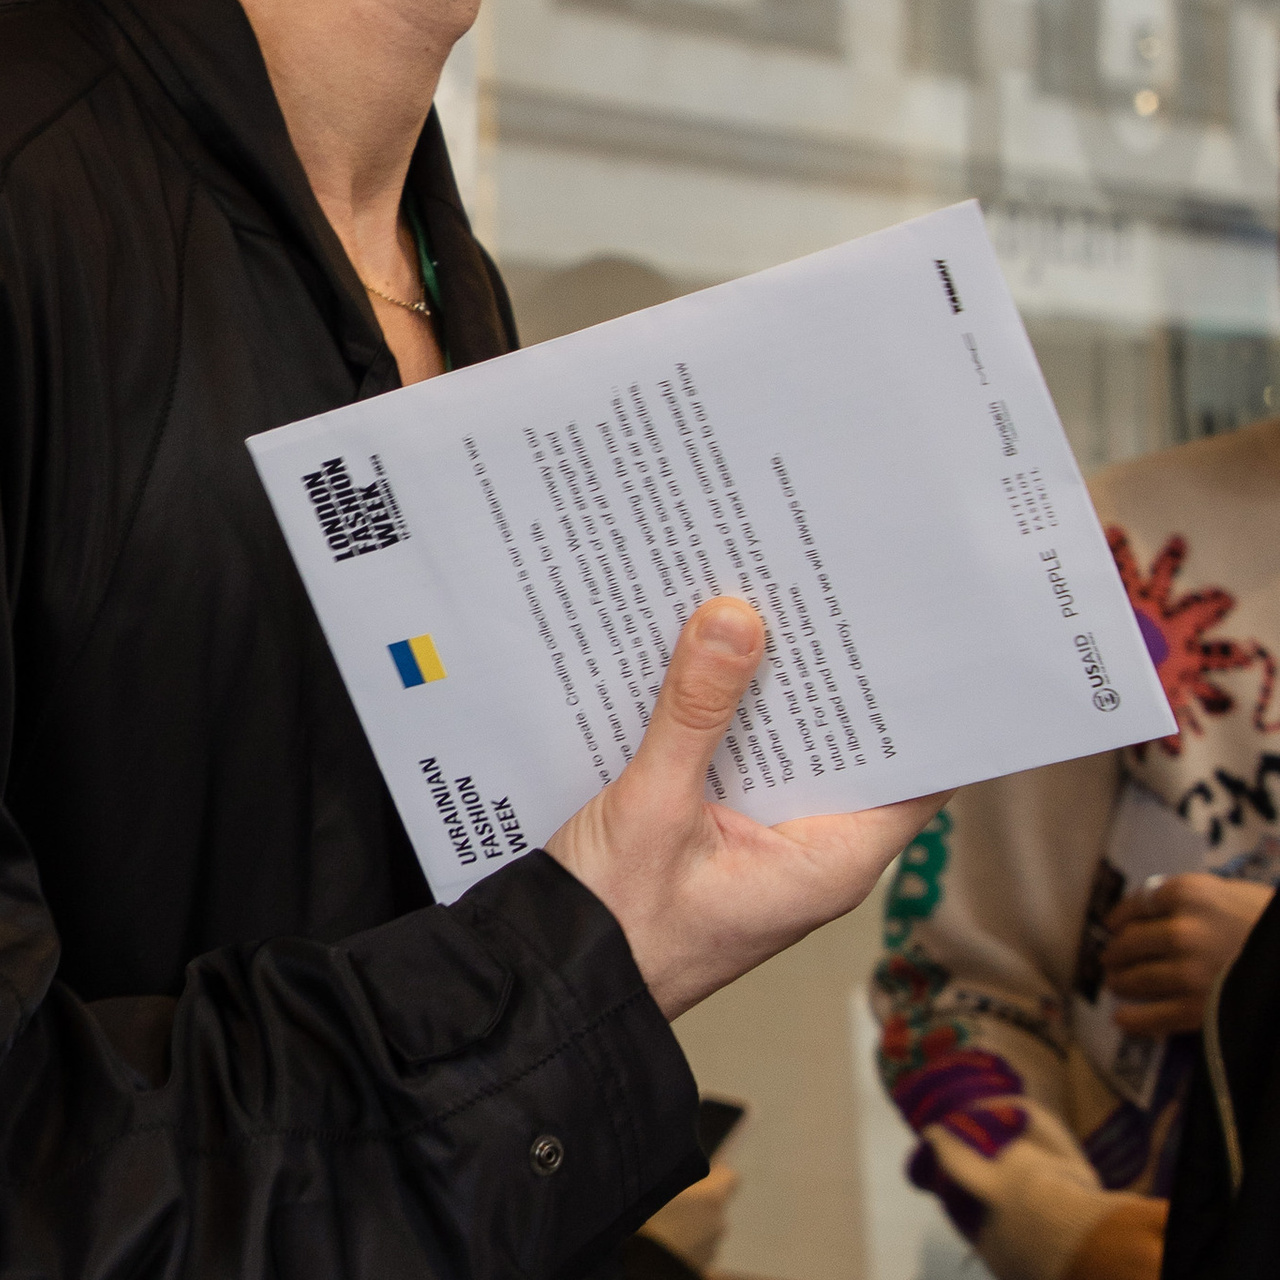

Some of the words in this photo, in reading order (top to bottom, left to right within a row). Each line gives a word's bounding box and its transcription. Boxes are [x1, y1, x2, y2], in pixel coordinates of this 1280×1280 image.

[674, 361, 697, 397] show
[627, 379, 664, 454] collections.
[655, 378, 694, 437] peaceful
[689, 400, 708, 422] our
[522, 426, 540, 449] our
[542, 430, 566, 456] and
[594, 420, 620, 454] most
[699, 423, 715, 439] to
[461, 432, 480, 461] war.
[532, 449, 546, 463] is
[565, 419, 602, 493] Ukrainians.
[626, 440, 644, 457] air
[472, 461, 487, 477] to
[611, 455, 629, 478] the
[631, 459, 650, 474] of
[656, 455, 674, 478] the
[682, 437, 714, 495] common
[705, 439, 735, 488] season
[769, 451, 796, 498] create.
[537, 464, 567, 512] runway
[556, 457, 588, 511] strength
[621, 478, 636, 493] in
[665, 478, 682, 497] on
[319, 455, 381, 557] FASHION
[479, 477, 515, 544] resistance
[591, 493, 610, 510] all
[641, 474, 670, 523] sounds
[706, 497, 724, 520] our
[724, 489, 748, 520] next
[299, 469, 357, 564] LONDON
[355, 479, 401, 550] WEEK
[580, 513, 598, 536] our
[598, 511, 616, 526] of
[627, 493, 657, 546] working
[672, 498, 695, 532] work
[713, 521, 731, 535] of
[787, 499, 815, 546] always
[529, 518, 546, 543] life.
[557, 512, 582, 553] Week
[586, 537, 604, 552] of
[662, 524, 680, 548] the
[687, 532, 702, 548] to
[738, 521, 761, 547] you
[506, 545, 524, 568] our
[538, 544, 554, 563] for
[608, 527, 638, 581] courage
[722, 537, 745, 569] sake
[746, 548, 765, 562] of
[803, 547, 824, 571] will
[516, 568, 530, 582] is
[574, 552, 604, 606] Fashion
[594, 552, 629, 612] fulfilment
[648, 546, 678, 598] Despite
[671, 549, 696, 587] under
[691, 548, 723, 598] ontinue
[737, 570, 755, 593] the
[753, 563, 772, 580] all
[545, 564, 578, 621] creativity
[630, 582, 648, 605] the
[816, 572, 833, 593] we
[1038, 547, 1079, 619] PURPLE
[521, 582, 558, 650] collections
[636, 605, 654, 620] of
[667, 598, 695, 631] hing.
[763, 581, 791, 629] inviting
[787, 582, 816, 638] Ukraine.
[822, 594, 842, 618] but
[596, 606, 625, 656] London
[620, 613, 639, 635] the
[779, 630, 797, 645] of
[567, 621, 593, 656] need
[630, 635, 644, 649] is
[644, 621, 673, 667] flection
[808, 638, 828, 666] free
[834, 618, 863, 671] destroy,
[584, 657, 601, 678] we
[617, 656, 634, 679] the
[635, 649, 655, 680] This
[766, 655, 784, 669] of
[789, 646, 811, 679] sake
[1072, 633, 1105, 689] USAID
[549, 650, 580, 707] Creating
[626, 679, 641, 698] on
[645, 681, 663, 698] ill.
[744, 676, 763, 697] ou
[773, 670, 792, 687] all
[802, 680, 820, 703] the
[816, 667, 838, 693] and
[854, 673, 879, 710] never
[594, 678, 614, 711] ever,
[781, 688, 803, 716] that
[631, 700, 653, 727] how
[733, 706, 754, 732] and
[753, 697, 773, 726] with
[811, 705, 830, 728] For
[826, 694, 862, 752] liberated
[867, 711, 888, 734] will
[574, 707, 599, 752] create.
[606, 711, 627, 743] than
[793, 717, 817, 752] know
[591, 753, 605, 768] to
[620, 743, 636, 762] ore
[724, 734, 749, 775] create
[746, 733, 777, 789] unstable
[765, 728, 796, 785] Together
[823, 729, 847, 772] future.
[853, 752, 867, 767] in
[879, 735, 898, 760] We
[595, 768, 613, 785] ve
[808, 753, 826, 777] We
[699, 760, 727, 801] resilie
[741, 775, 756, 794] To
[416, 755, 478, 867] UKRAINIAN
[452, 774, 505, 860] FASHION
[488, 794, 529, 855] WEEK
